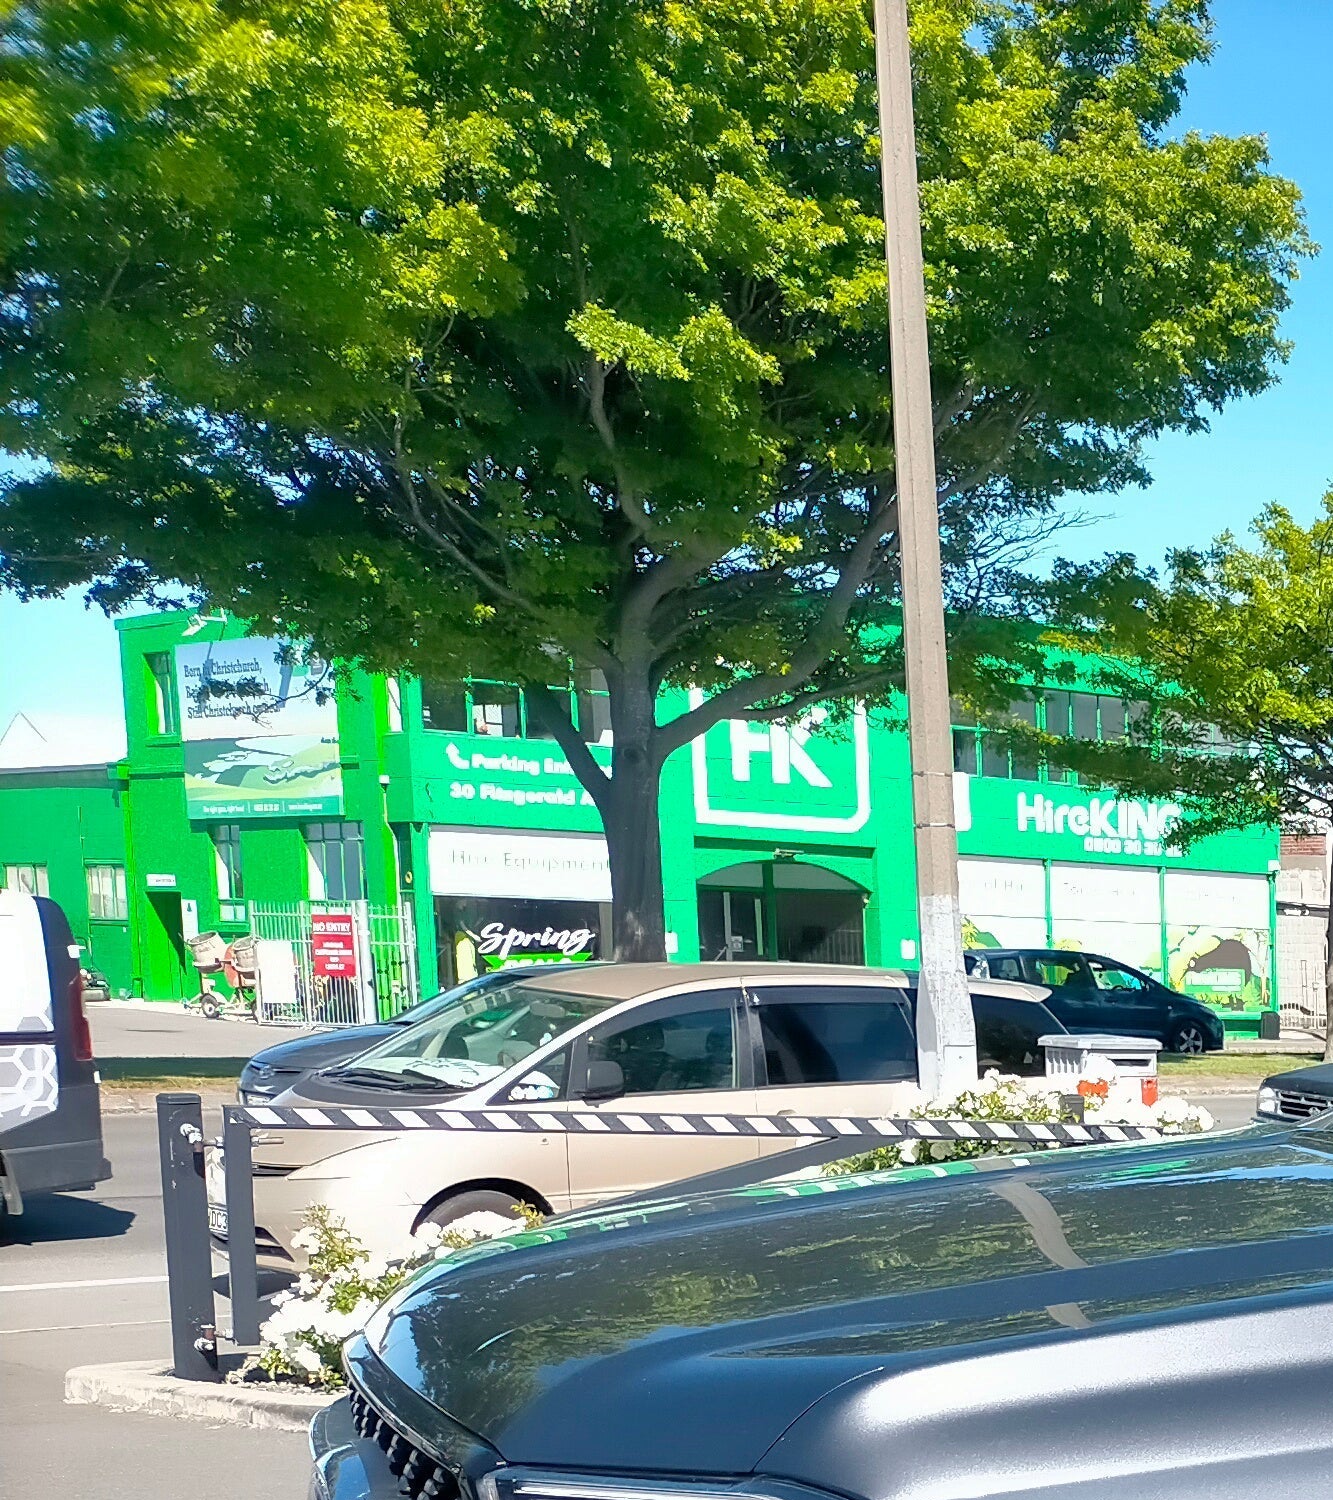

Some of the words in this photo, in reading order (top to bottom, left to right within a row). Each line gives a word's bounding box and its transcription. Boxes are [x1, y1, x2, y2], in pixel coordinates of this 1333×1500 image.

[471, 753, 540, 776] Parking
[450, 781, 476, 800] 30
[326, 922, 351, 933] ENTRY
[478, 922, 596, 960] Spring
